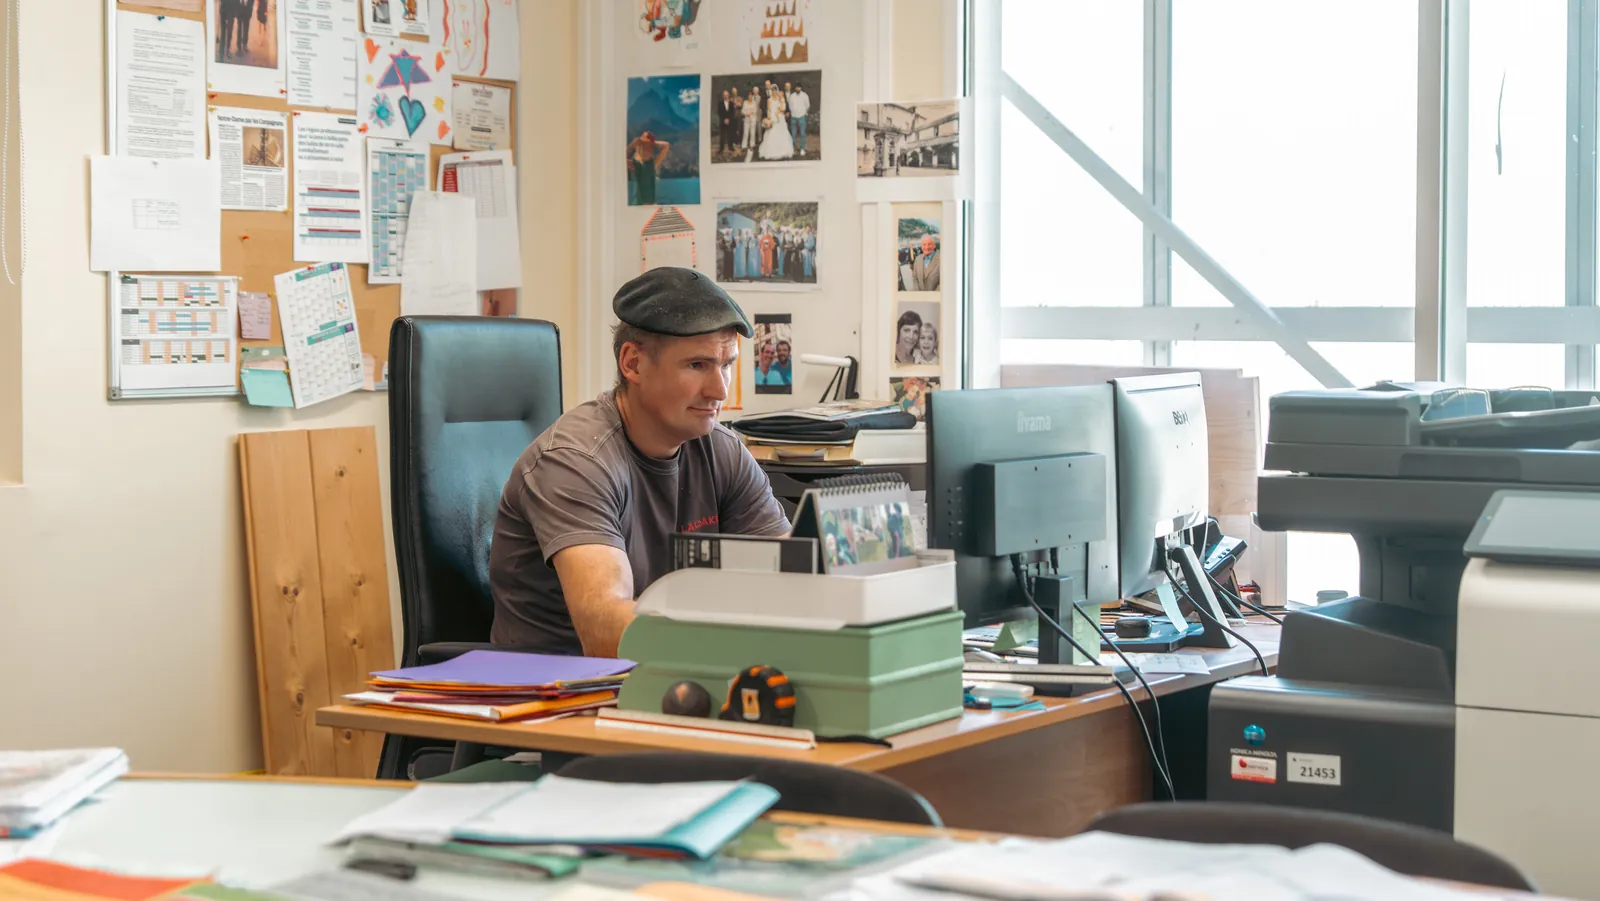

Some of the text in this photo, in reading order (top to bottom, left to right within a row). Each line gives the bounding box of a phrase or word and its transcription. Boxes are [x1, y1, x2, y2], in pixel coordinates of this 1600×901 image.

[1230, 747, 1277, 758] KONICA MINOLTA
[1300, 766, 1336, 779] 21453
